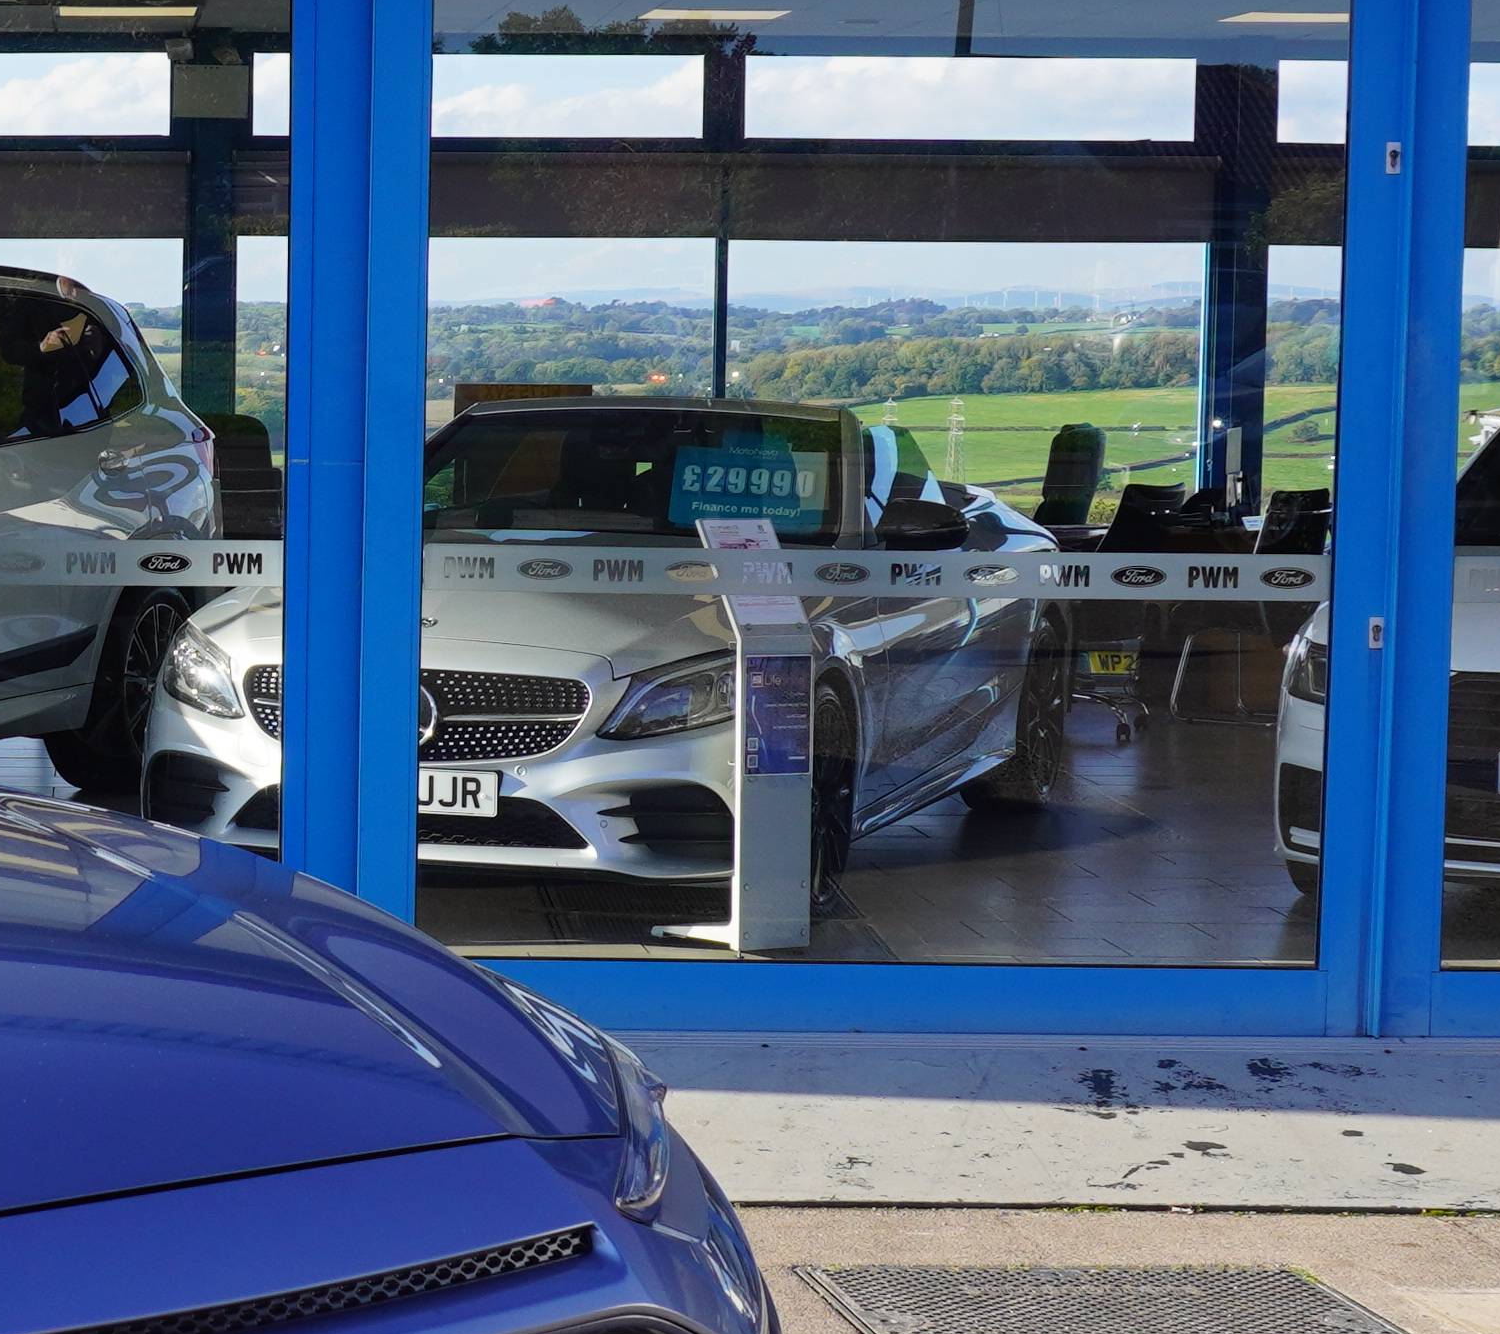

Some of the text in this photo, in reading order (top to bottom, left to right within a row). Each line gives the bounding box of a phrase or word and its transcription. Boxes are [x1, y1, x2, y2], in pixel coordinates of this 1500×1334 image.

[682, 464, 816, 498] £29990
[691, 501, 801, 517] Finance me today!
[66, 551, 116, 575] PWM
[145, 554, 184, 573] Ford
[212, 552, 262, 575] PWM
[443, 556, 495, 579] PWM
[525, 559, 565, 578] Ford
[592, 558, 644, 582] PWM
[823, 564, 862, 583] Ford
[890, 563, 942, 587] PWM
[1039, 564, 1090, 587] PWM
[1119, 566, 1159, 585] Ford
[1188, 565, 1239, 589] PWM
[1268, 568, 1308, 587] Ford
